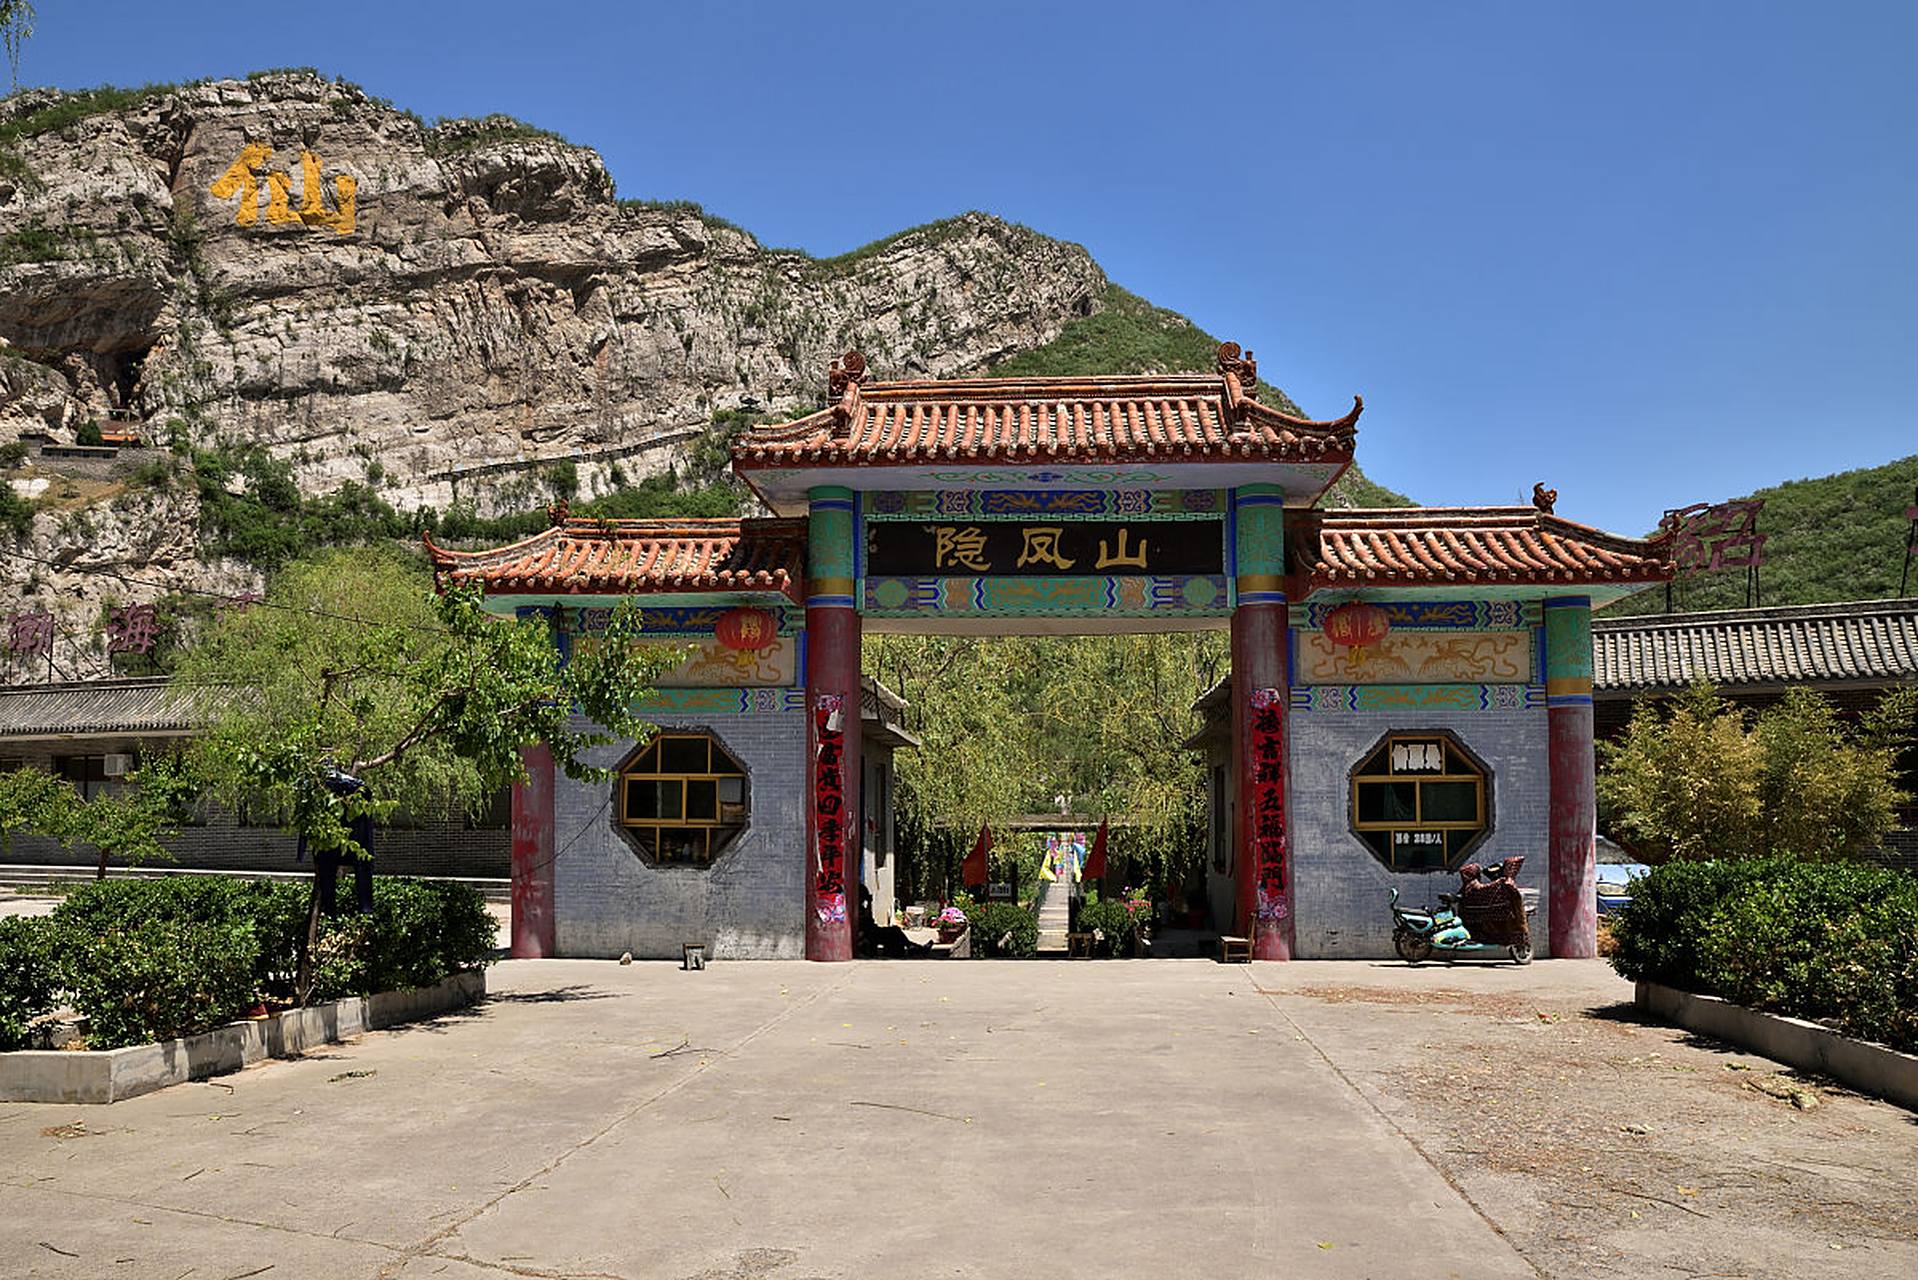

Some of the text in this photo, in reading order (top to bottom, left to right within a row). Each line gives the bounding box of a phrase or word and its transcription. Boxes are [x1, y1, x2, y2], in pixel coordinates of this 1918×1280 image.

[209, 141, 356, 235] 仙
[936, 526, 1148, 571] 隐凤山
